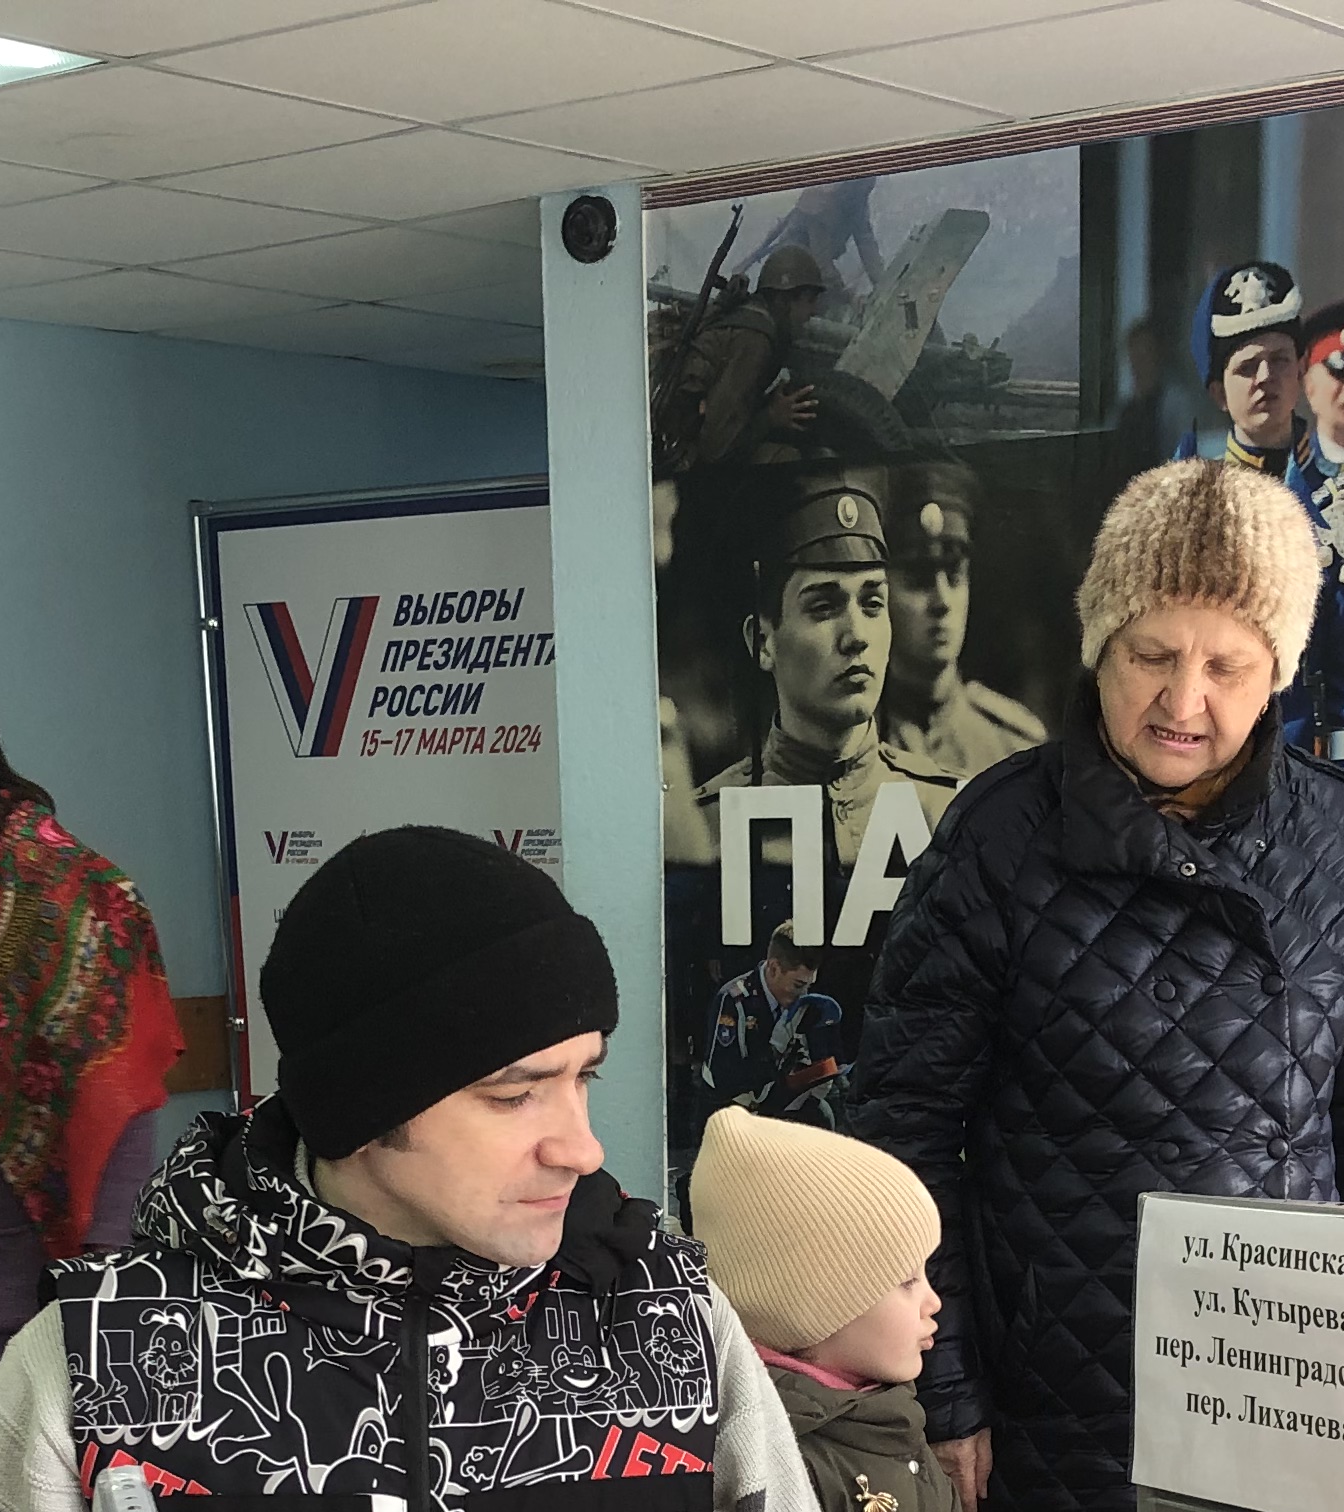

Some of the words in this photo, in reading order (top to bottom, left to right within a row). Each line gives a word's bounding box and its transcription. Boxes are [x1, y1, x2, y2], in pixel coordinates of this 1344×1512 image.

[393, 587, 525, 627] ВЫБОРЫ
[368, 682, 485, 718] РОССИИ
[416, 726, 484, 757] МАРТА
[489, 724, 542, 755] 2024
[1182, 1233, 1213, 1264] ул.
[1193, 1289, 1226, 1317] ул.
[1155, 1335, 1201, 1369] пер.
[1186, 1392, 1231, 1425] пер.
